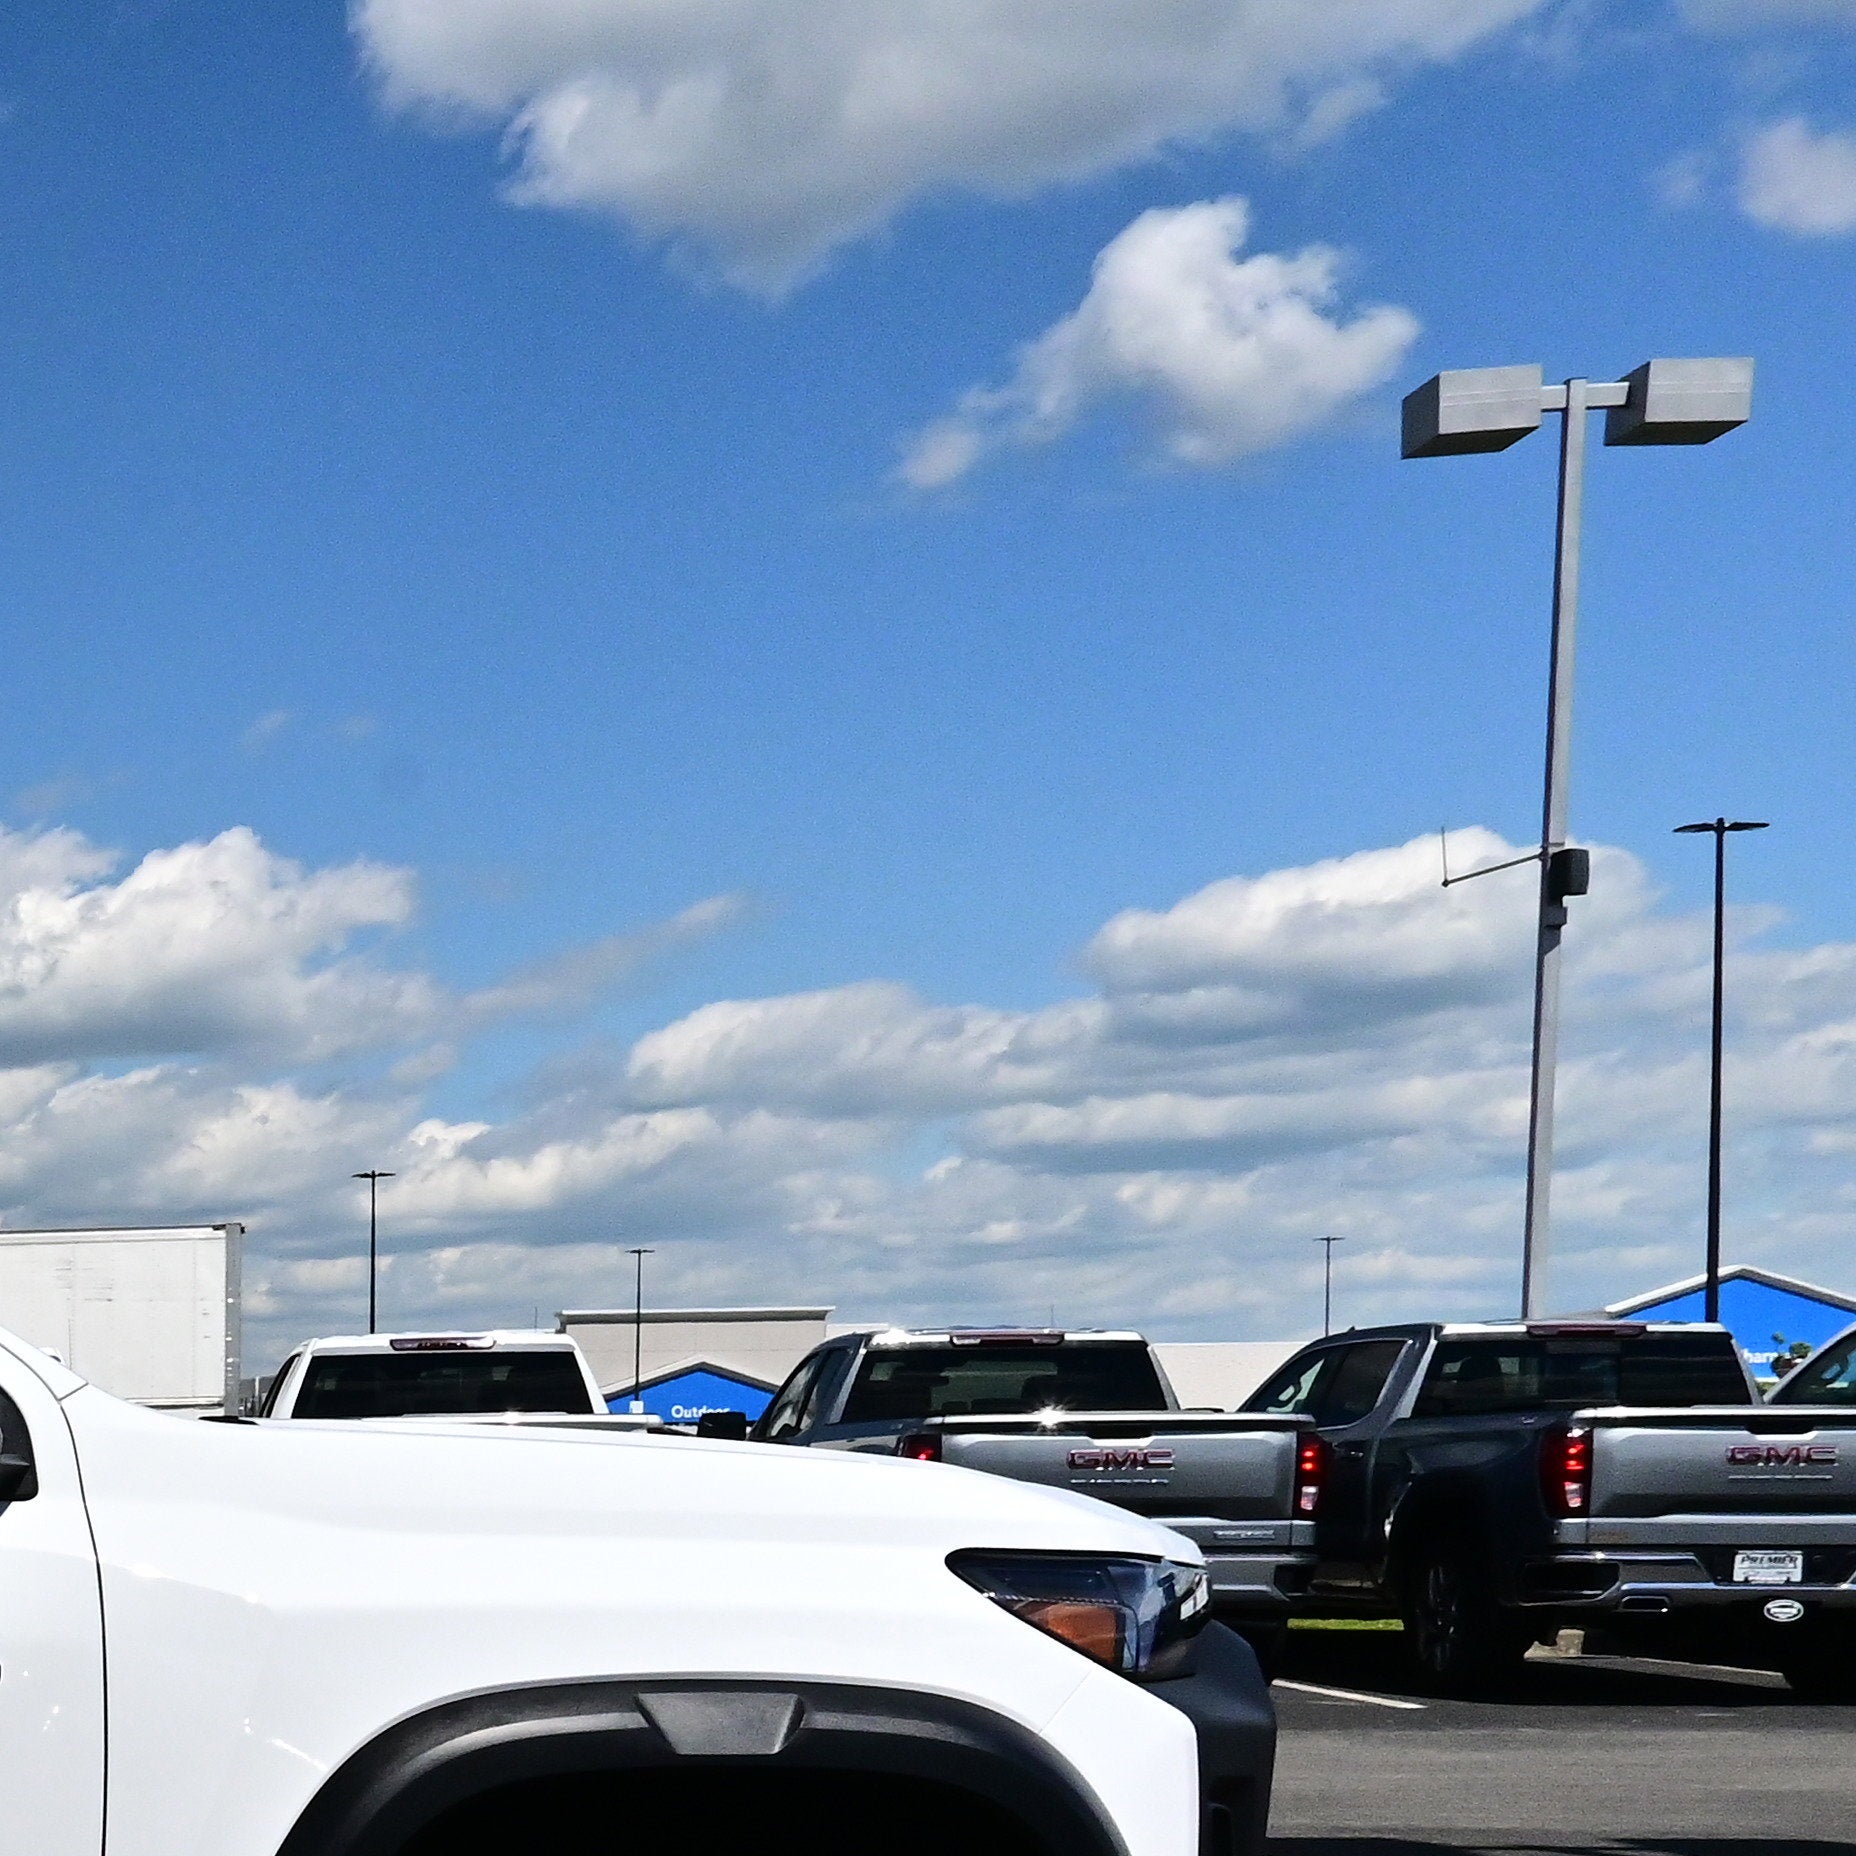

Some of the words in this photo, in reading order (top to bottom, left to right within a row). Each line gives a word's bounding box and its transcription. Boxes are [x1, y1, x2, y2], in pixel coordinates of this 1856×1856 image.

[1066, 1447, 1176, 1470] GMC
[1726, 1444, 1839, 1466] GMC
[1740, 1553, 1799, 1568] PREMIER
